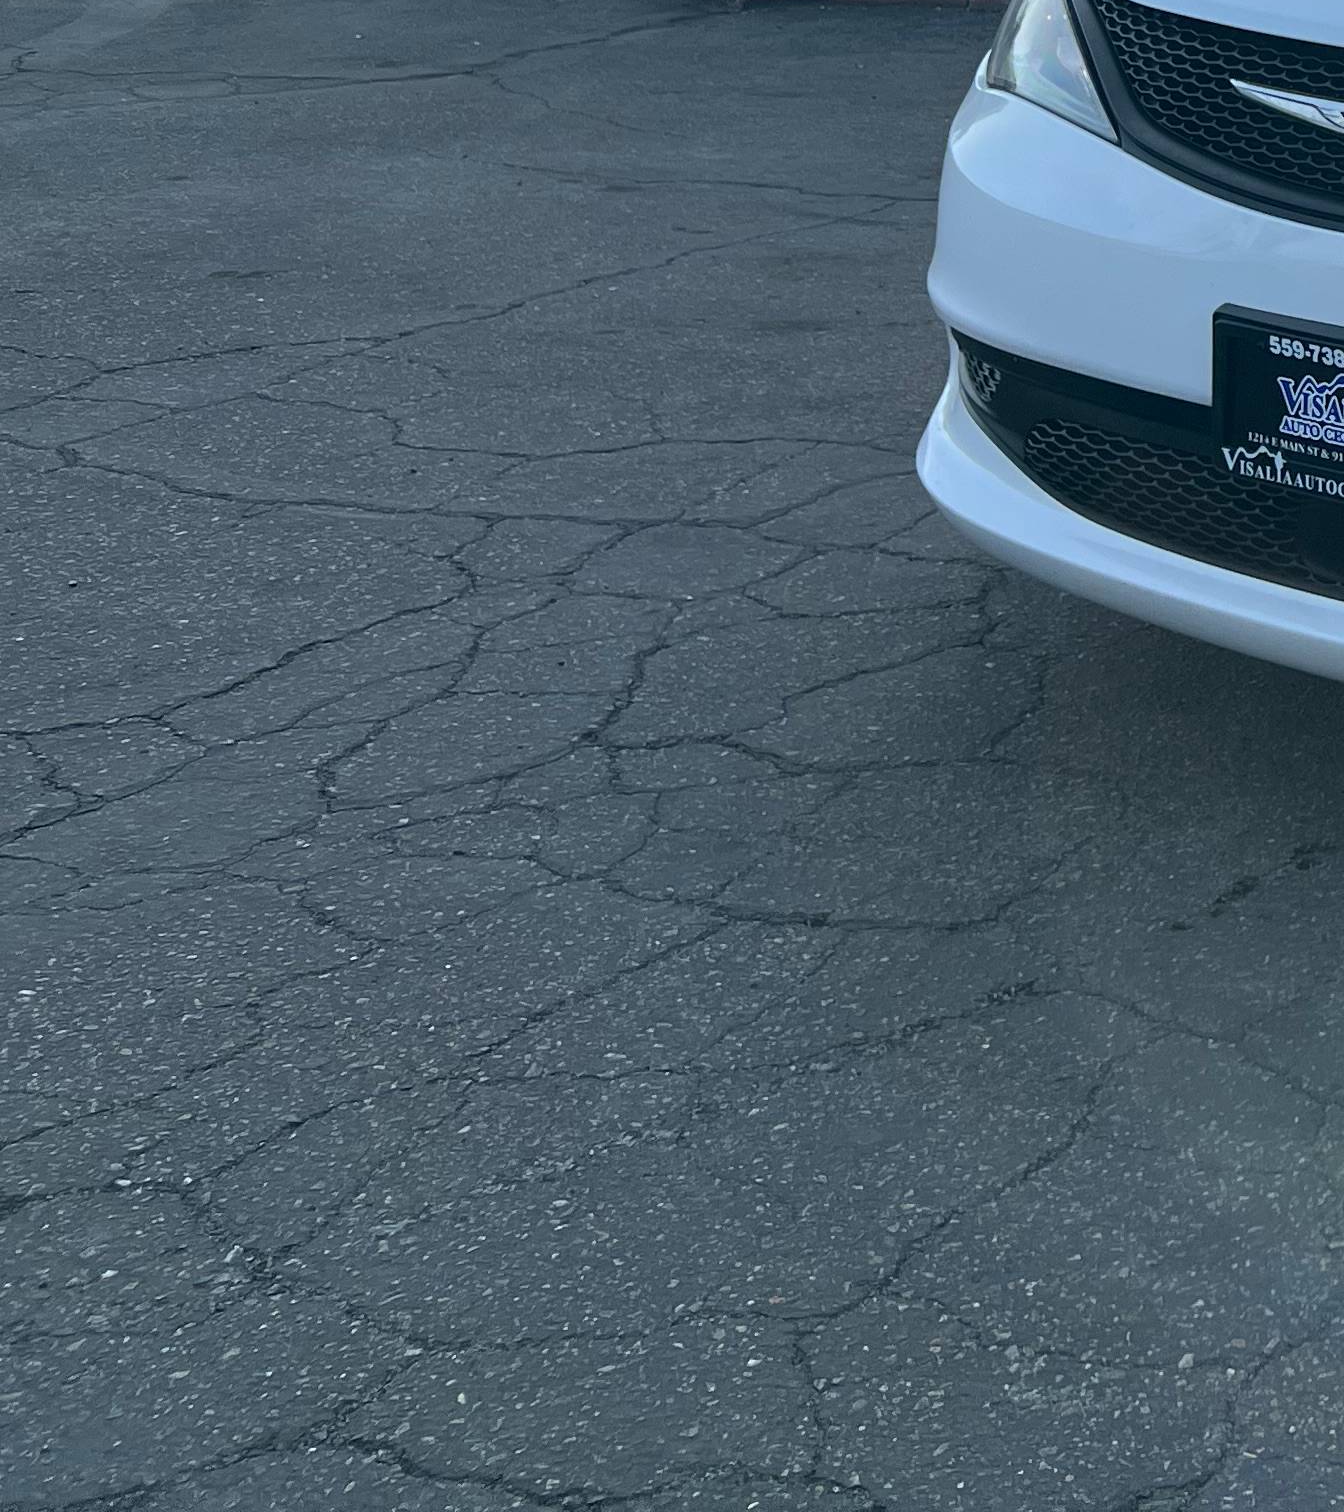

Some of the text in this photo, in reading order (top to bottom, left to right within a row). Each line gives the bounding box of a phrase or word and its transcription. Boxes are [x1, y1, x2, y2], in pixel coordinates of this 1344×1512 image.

[1280, 416, 1321, 440] AUTO
[1280, 439, 1305, 454] MAIN
[1307, 446, 1320, 457] ST
[1320, 449, 1331, 460] &
